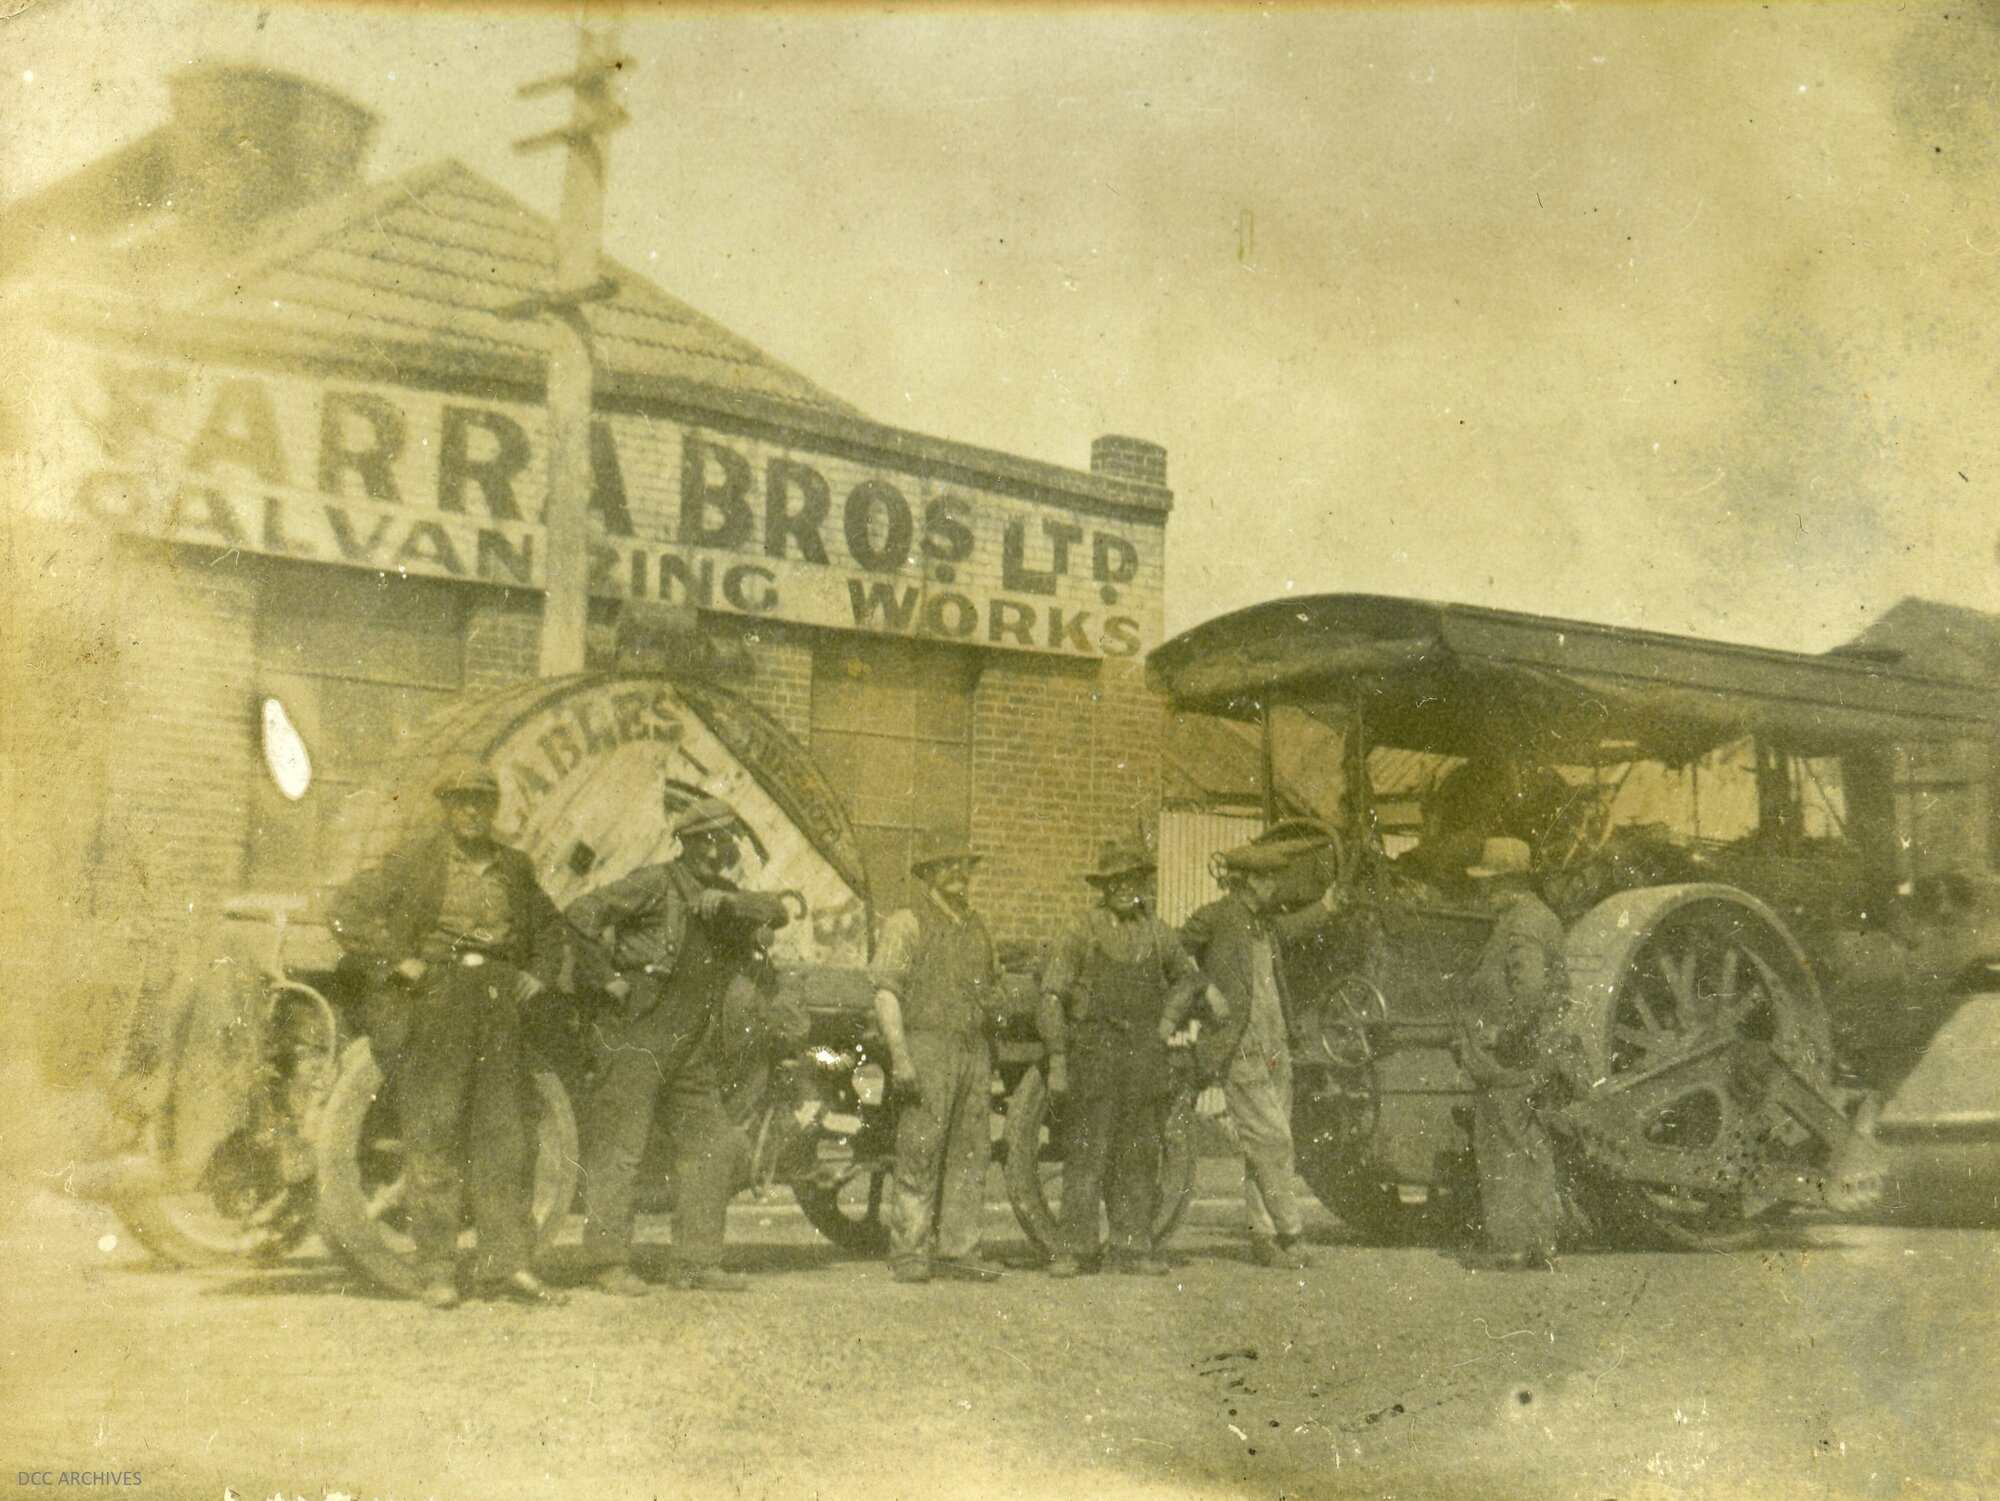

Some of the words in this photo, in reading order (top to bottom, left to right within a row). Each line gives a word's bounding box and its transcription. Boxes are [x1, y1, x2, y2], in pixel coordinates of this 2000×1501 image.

[78, 470, 778, 613] GALVANZING
[846, 577, 1143, 658] WORKS
[510, 690, 686, 838] ABLES
